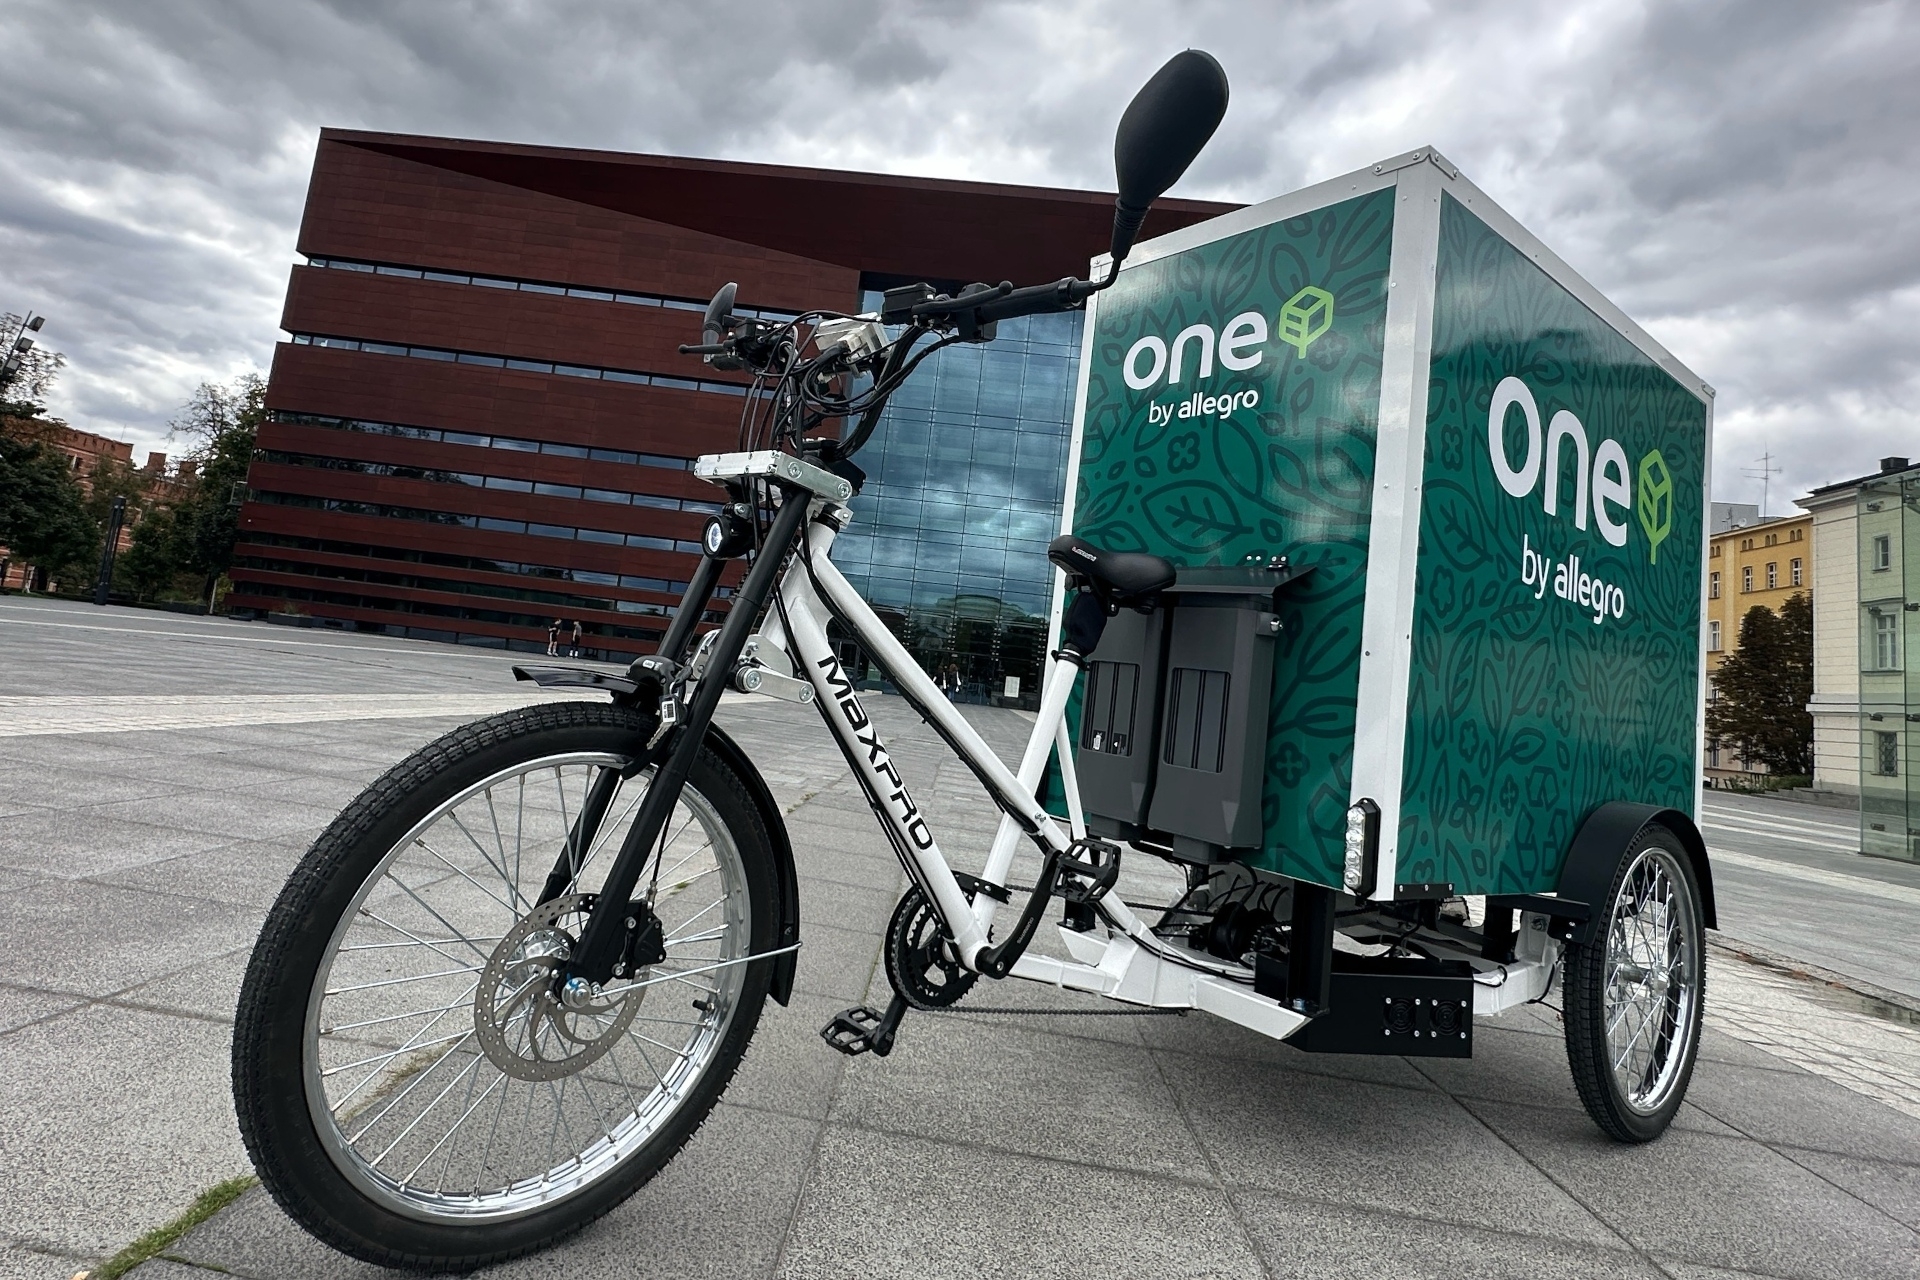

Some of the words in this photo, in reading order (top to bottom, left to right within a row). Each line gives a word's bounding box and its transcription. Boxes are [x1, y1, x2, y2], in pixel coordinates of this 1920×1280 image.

[1123, 312, 1267, 389] one
[1149, 401, 1174, 426] by
[1178, 390, 1258, 419] allegro
[1489, 376, 1630, 546] one
[1522, 534, 1550, 599] by
[1554, 554, 1624, 624] allegro
